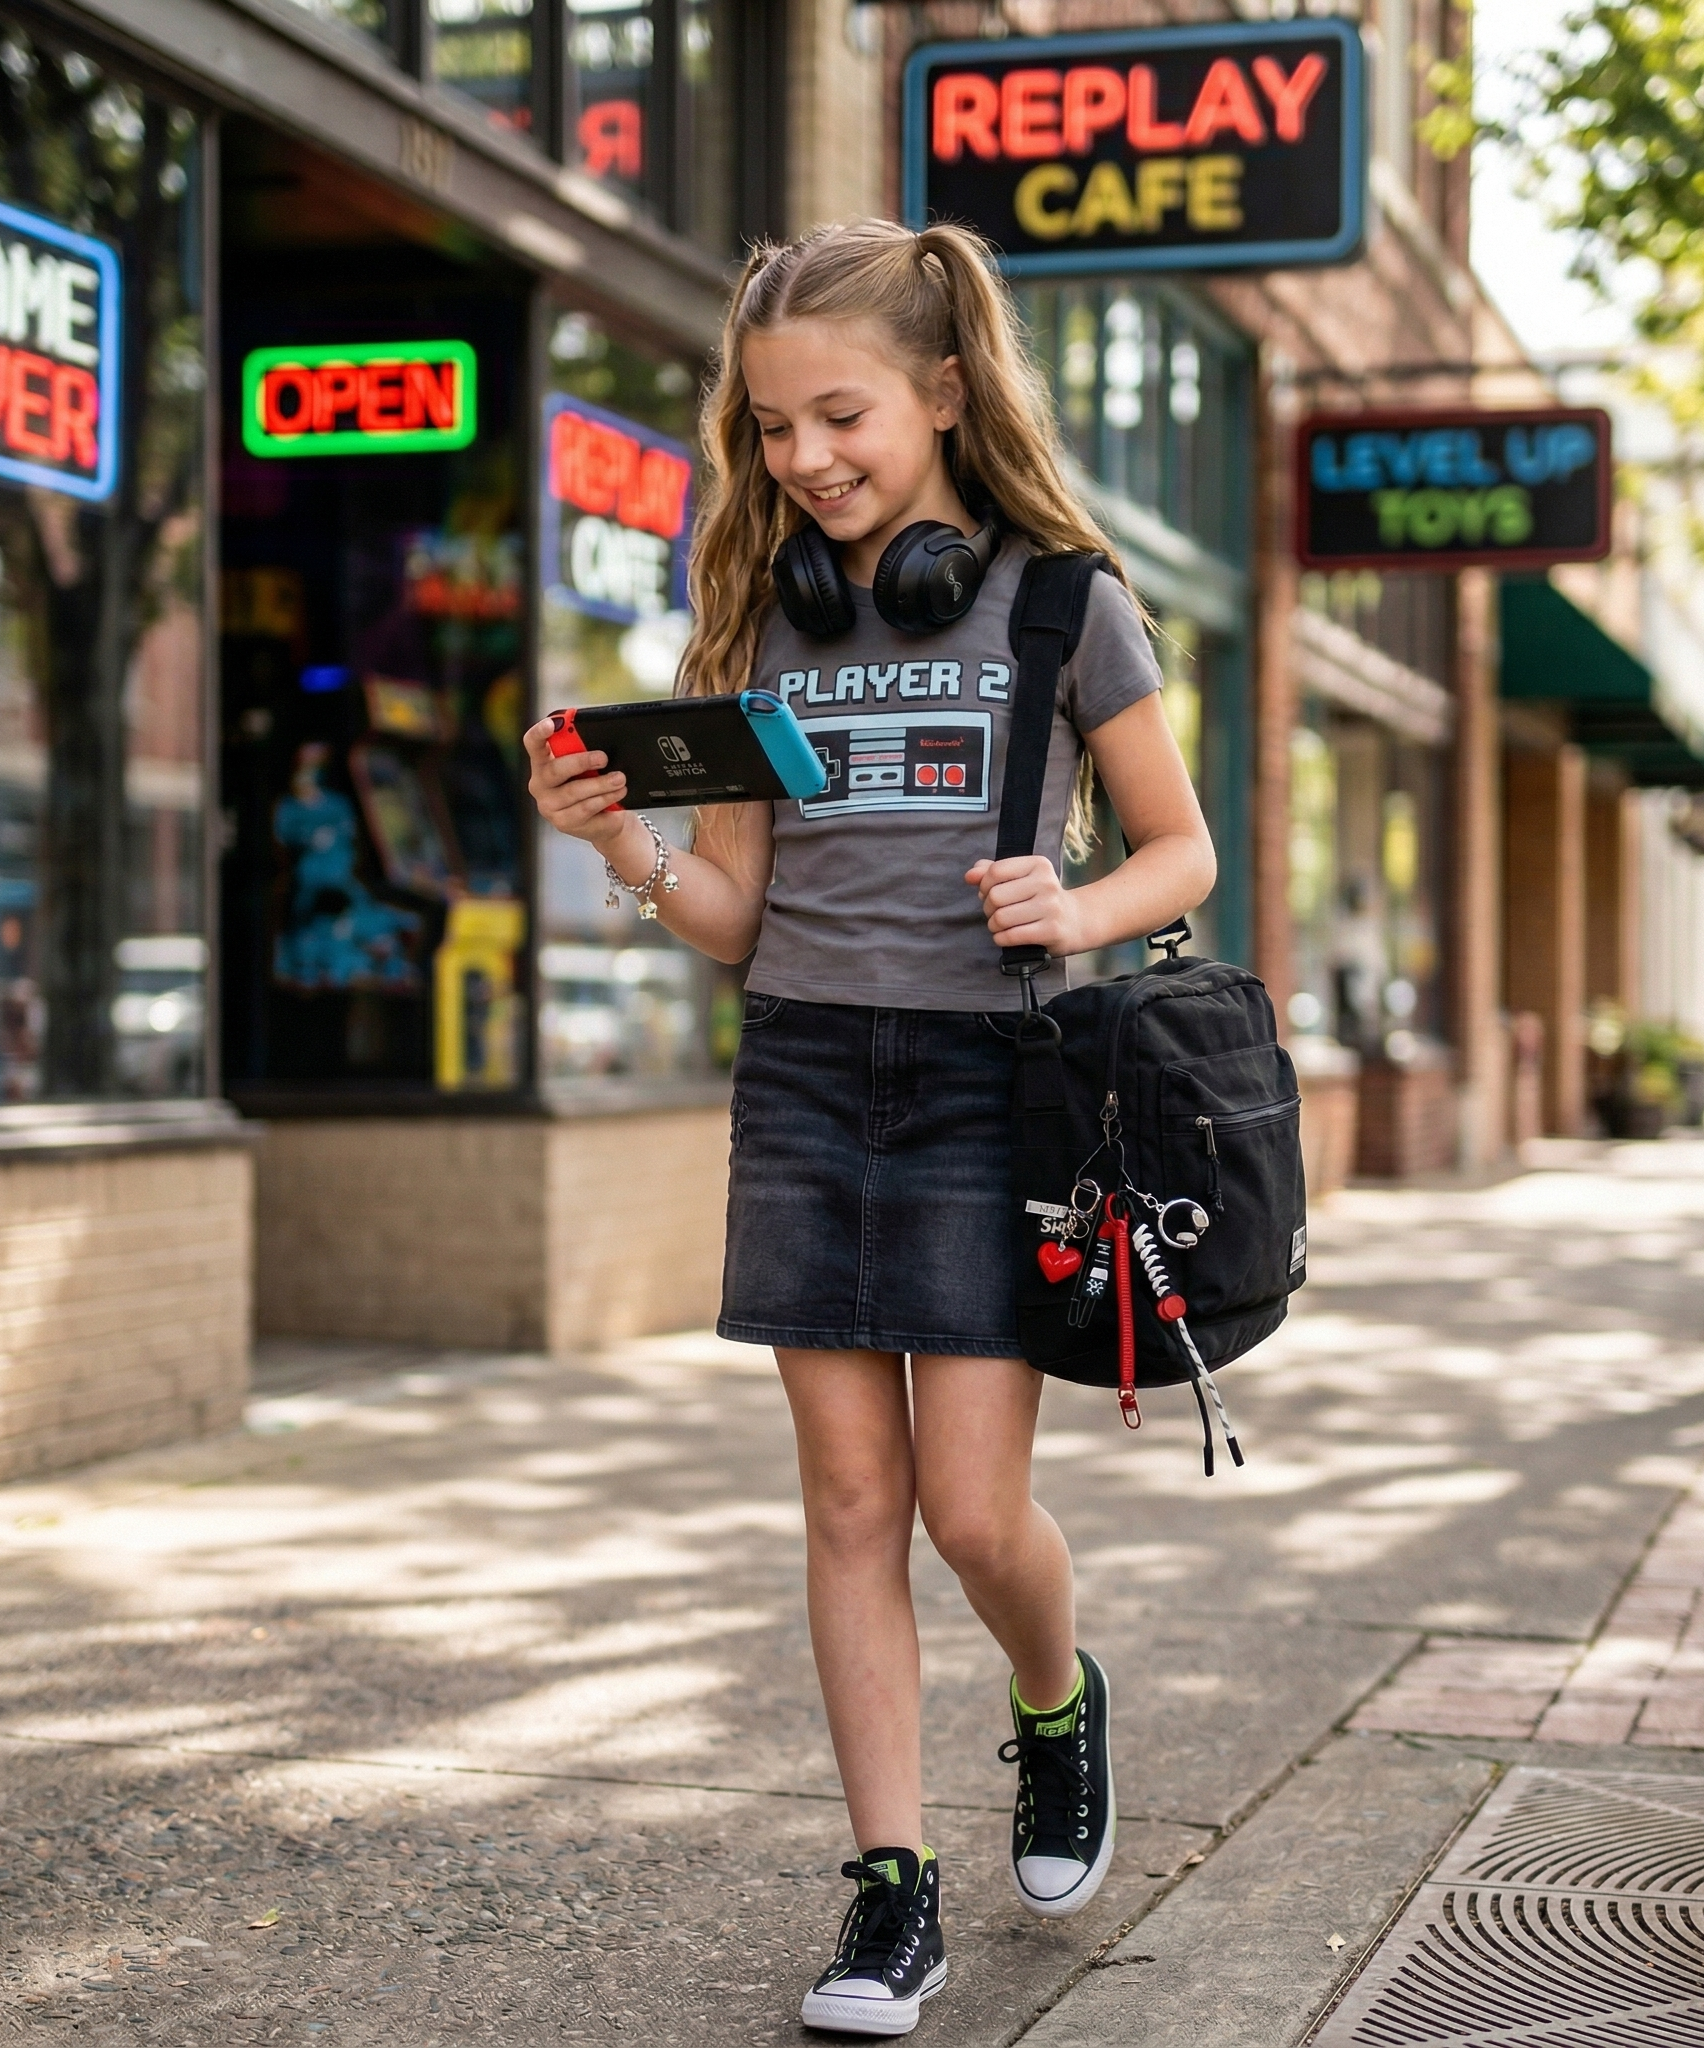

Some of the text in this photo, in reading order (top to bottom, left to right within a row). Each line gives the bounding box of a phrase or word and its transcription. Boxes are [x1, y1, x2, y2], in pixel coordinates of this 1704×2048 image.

[932, 53, 1329, 162] REPLAY
[1014, 155, 1245, 241] CAFE
[256, 358, 463, 442] OPEN
[1311, 423, 1597, 491] LEVEL UP
[779, 660, 1010, 703] PLAYER 2
